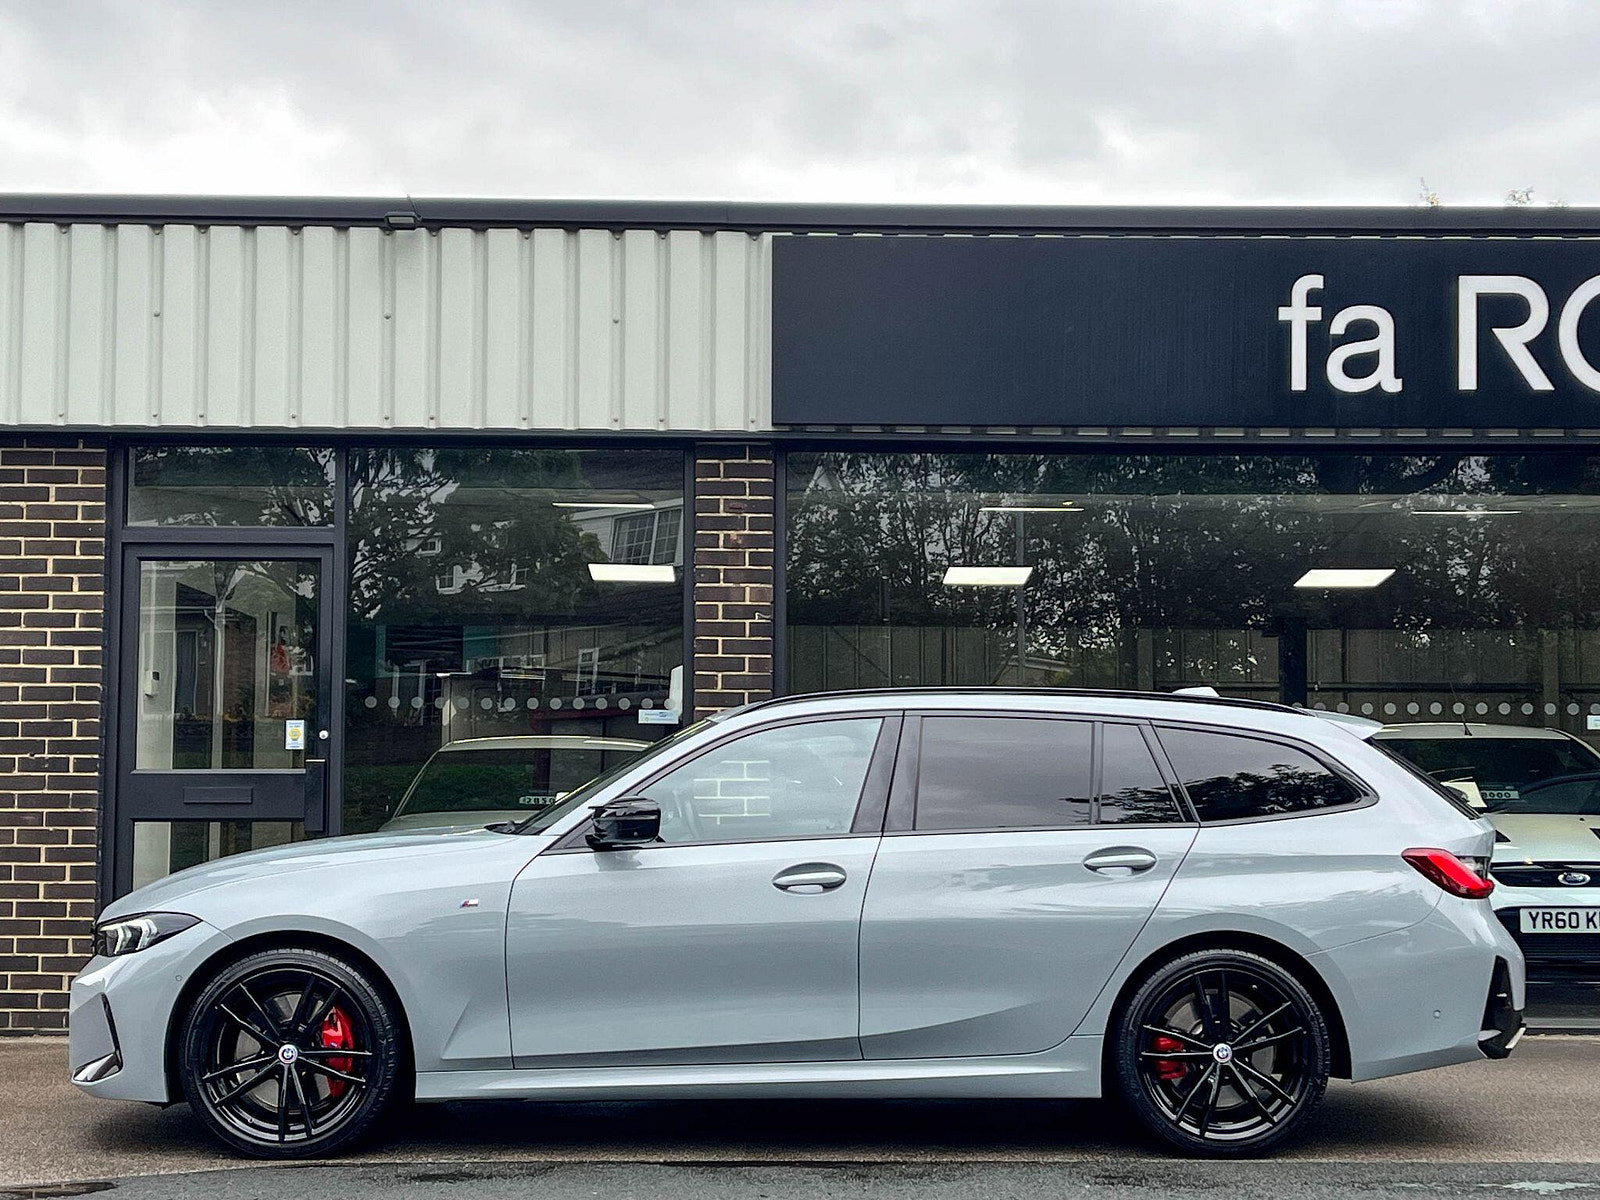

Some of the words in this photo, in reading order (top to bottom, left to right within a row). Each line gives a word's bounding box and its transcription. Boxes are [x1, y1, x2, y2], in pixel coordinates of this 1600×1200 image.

[1278, 274, 1403, 392] fa
[1528, 911, 1579, 929] YR60
[1586, 911, 1600, 929] K
